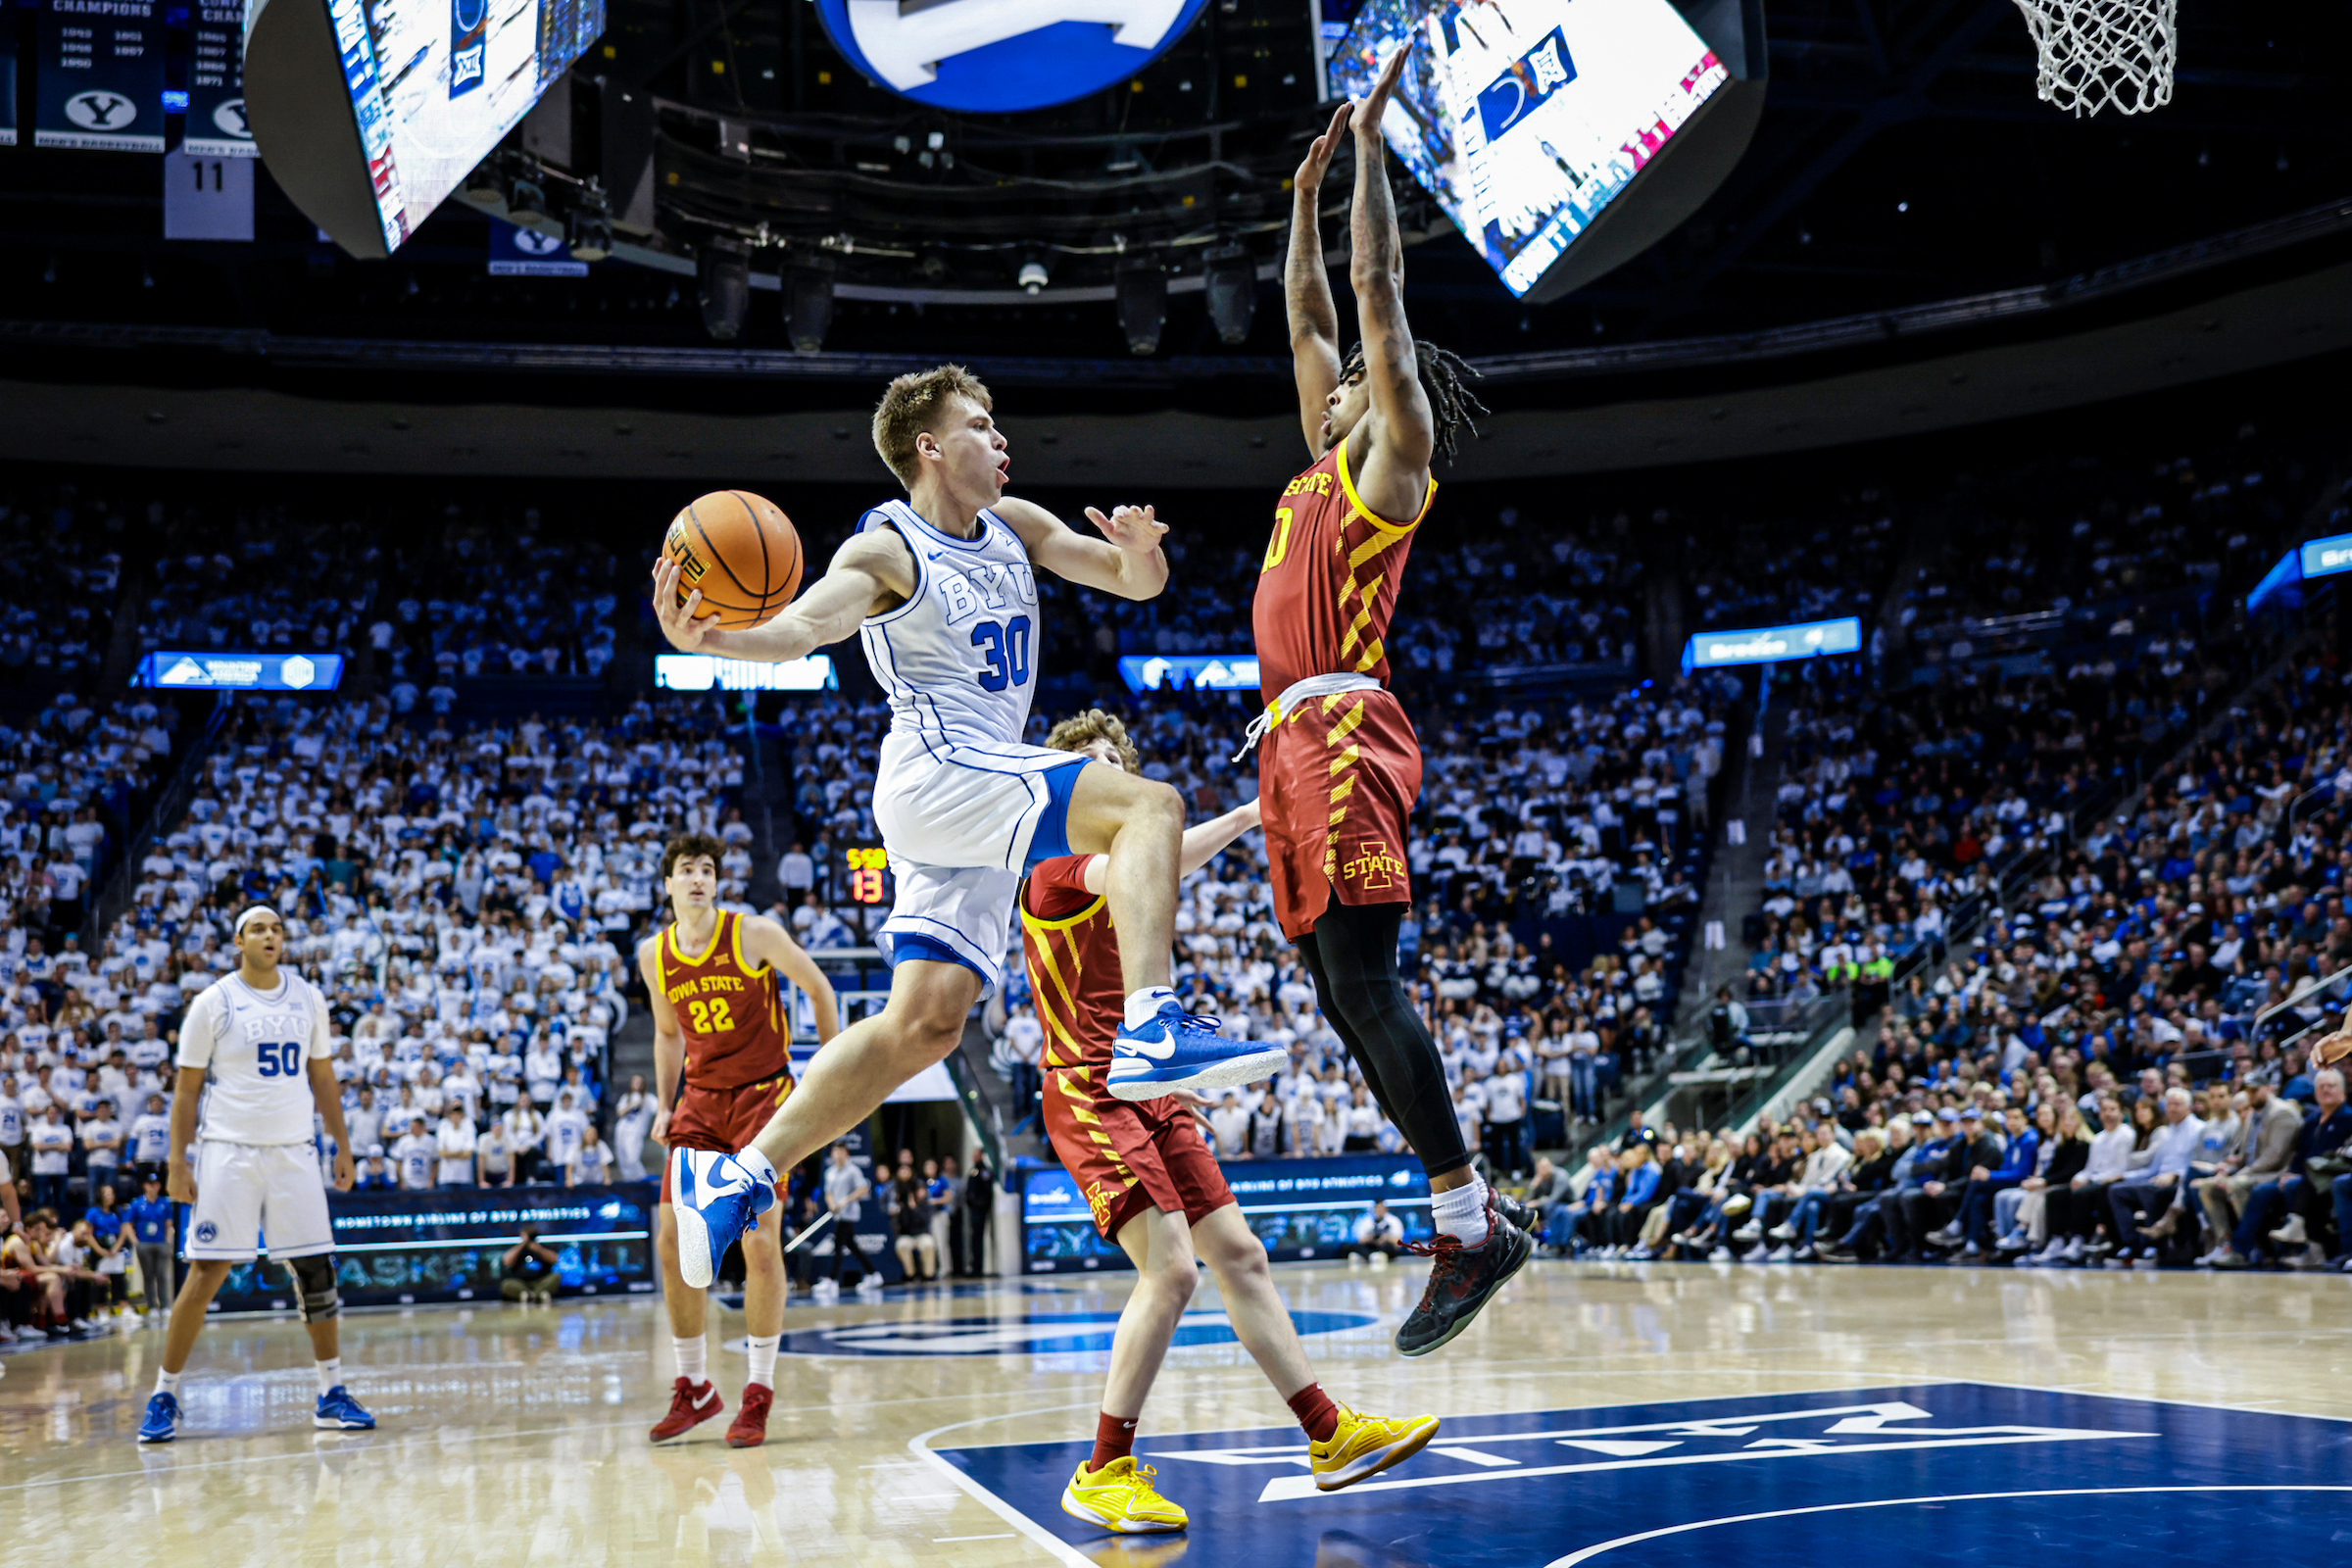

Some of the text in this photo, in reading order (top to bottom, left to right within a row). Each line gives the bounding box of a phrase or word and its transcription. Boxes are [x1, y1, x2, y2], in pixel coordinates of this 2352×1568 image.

[53, 0, 152, 17] CHAMPIONS
[78, 96, 123, 124] Y
[192, 161, 223, 192] 11
[939, 563, 1039, 625] BYU
[970, 614, 1031, 692] 30
[1344, 856, 1405, 881] STATE
[854, 868, 884, 904] 13
[667, 979, 700, 1004] IOWA
[700, 975, 745, 993] STATE
[245, 1014, 310, 1045] BYU
[688, 997, 735, 1034] 22
[258, 1042, 301, 1077] 50
[414, 1212, 467, 1226] AIRLINE
[468, 1210, 488, 1224] OF
[490, 1209, 518, 1223] BYU
[519, 1206, 591, 1222] ATHLETICS
